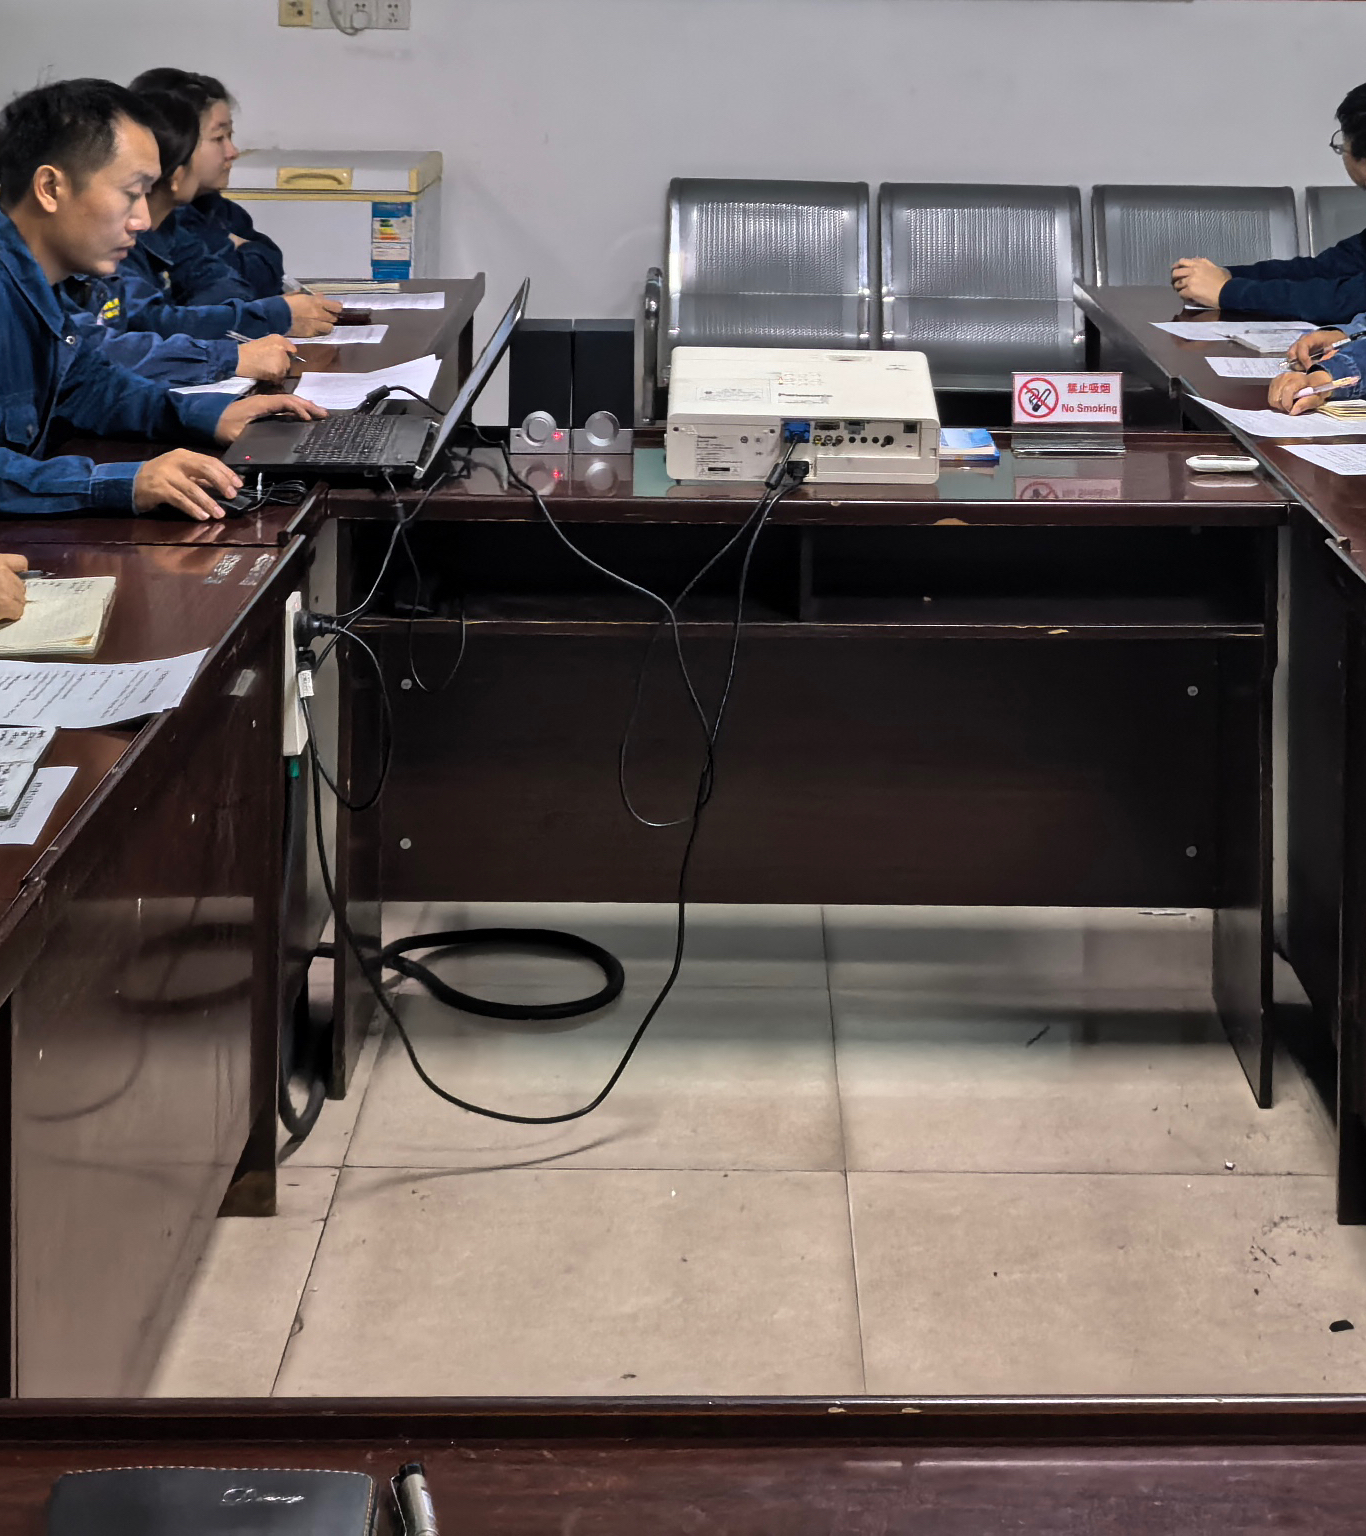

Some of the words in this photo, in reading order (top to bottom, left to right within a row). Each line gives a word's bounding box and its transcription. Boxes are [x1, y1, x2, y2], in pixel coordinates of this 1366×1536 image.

[1067, 383, 1111, 394] 禁止吸烟
[1061, 404, 1074, 413] No
[1077, 404, 1118, 414] Smoking
